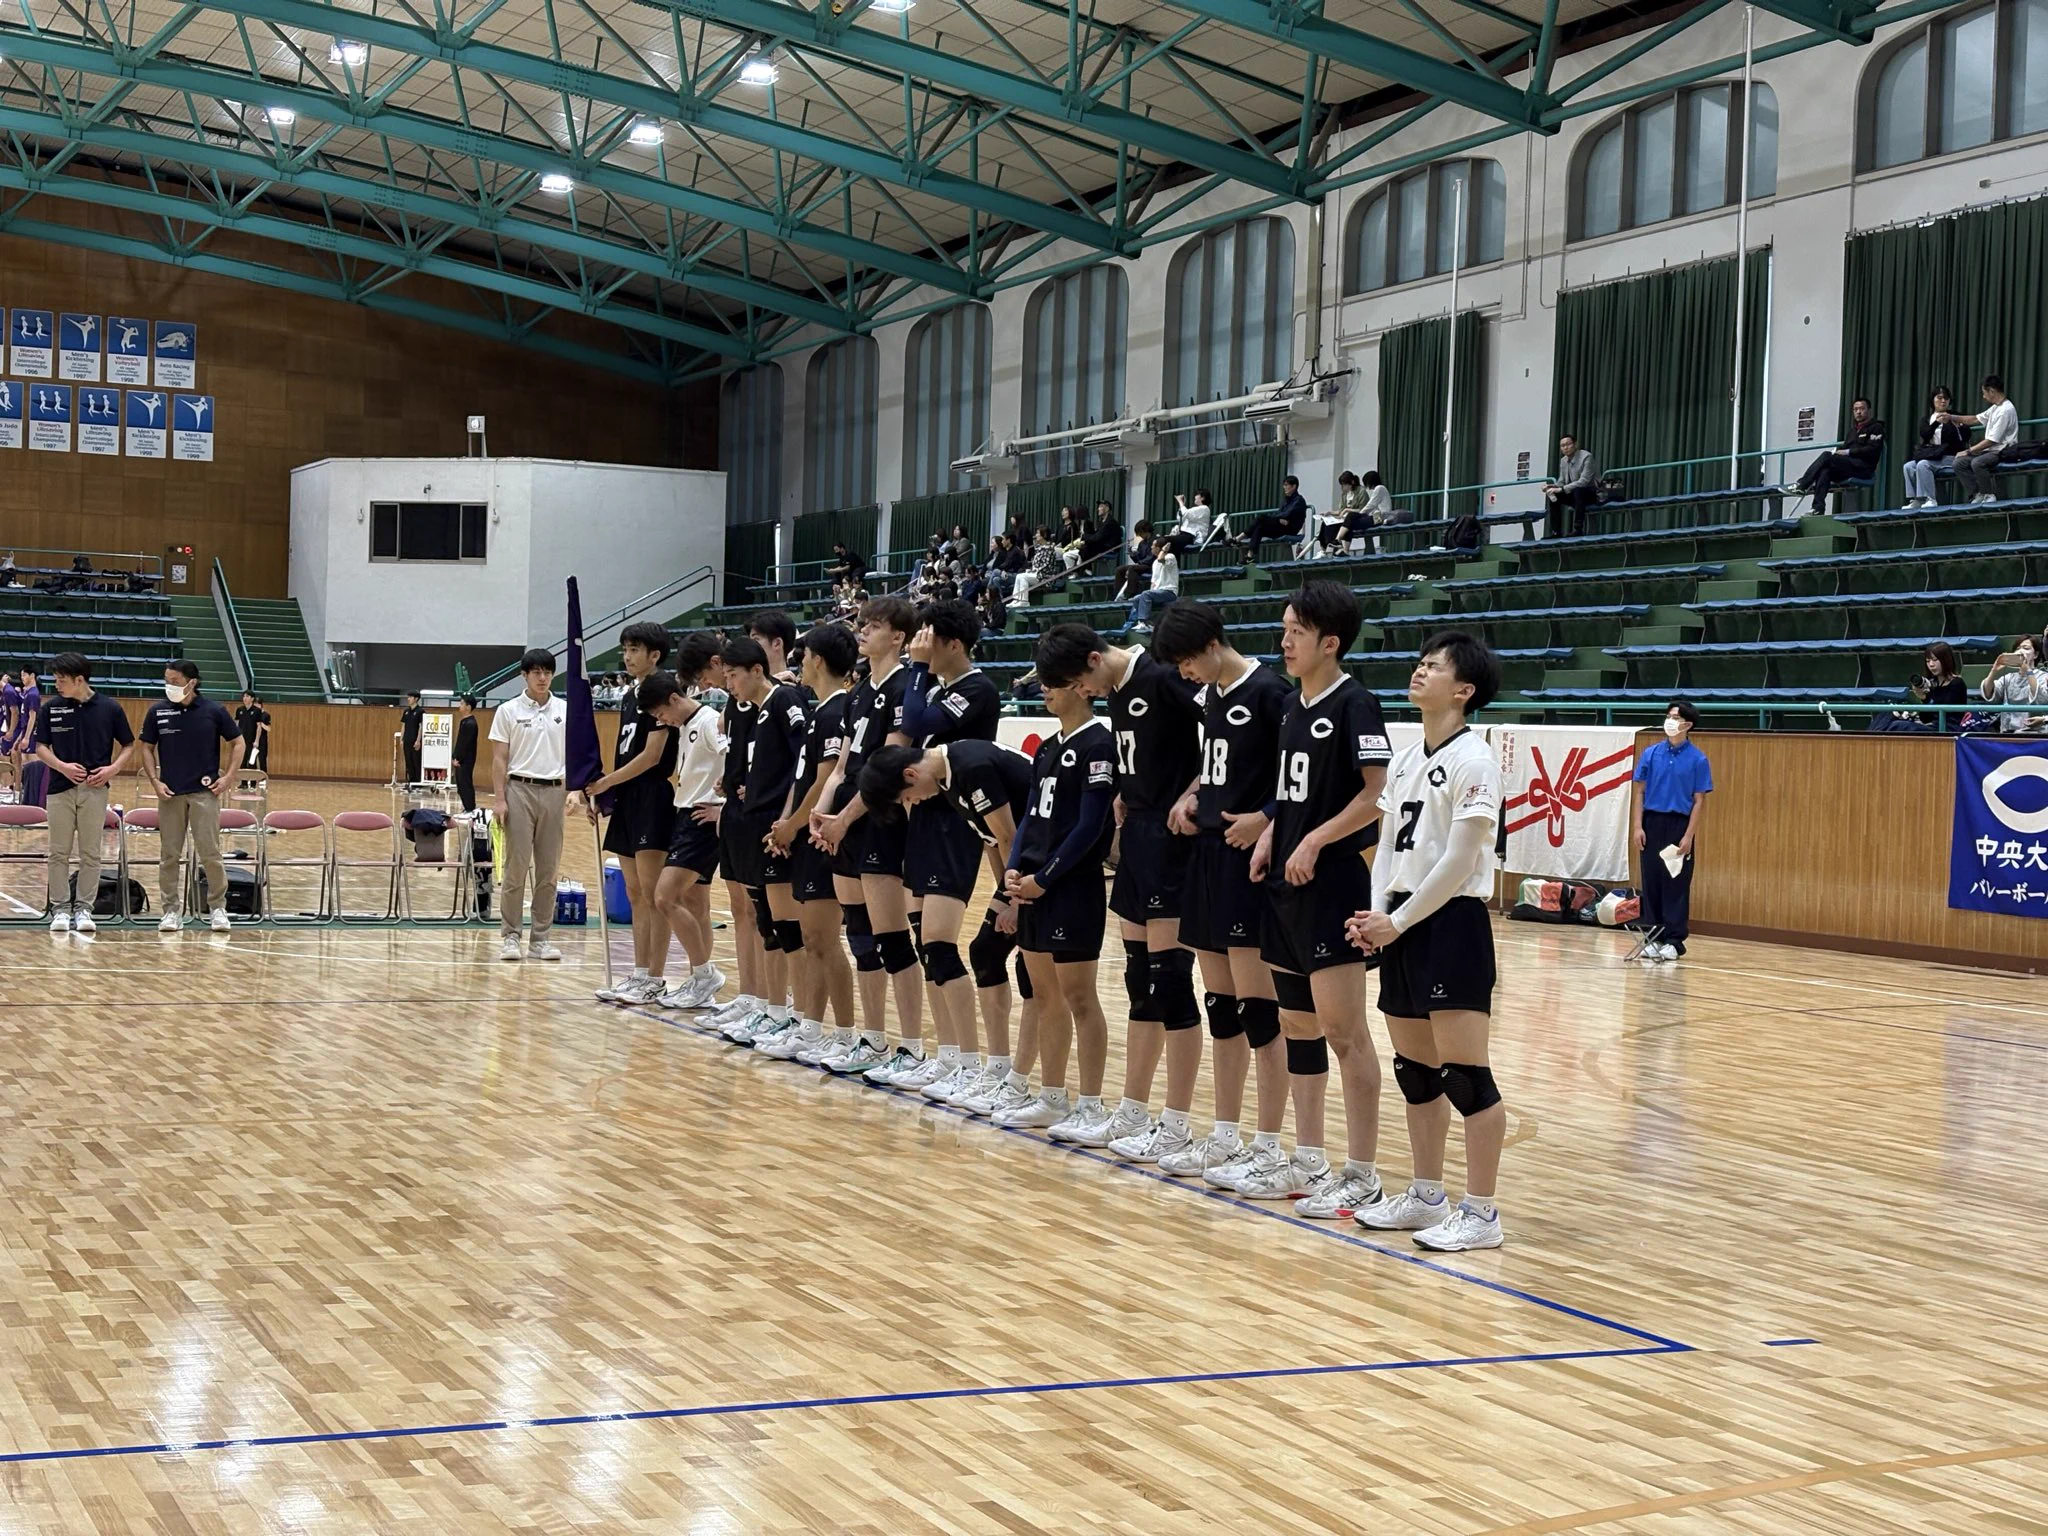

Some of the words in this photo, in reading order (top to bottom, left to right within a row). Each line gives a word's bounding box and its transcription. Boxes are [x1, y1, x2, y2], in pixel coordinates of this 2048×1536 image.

[1200, 738, 1228, 786] 18
[1276, 750, 1310, 802] 19
[1976, 834, 2048, 871] 中央大
[1969, 878, 2048, 904] バレーボー
